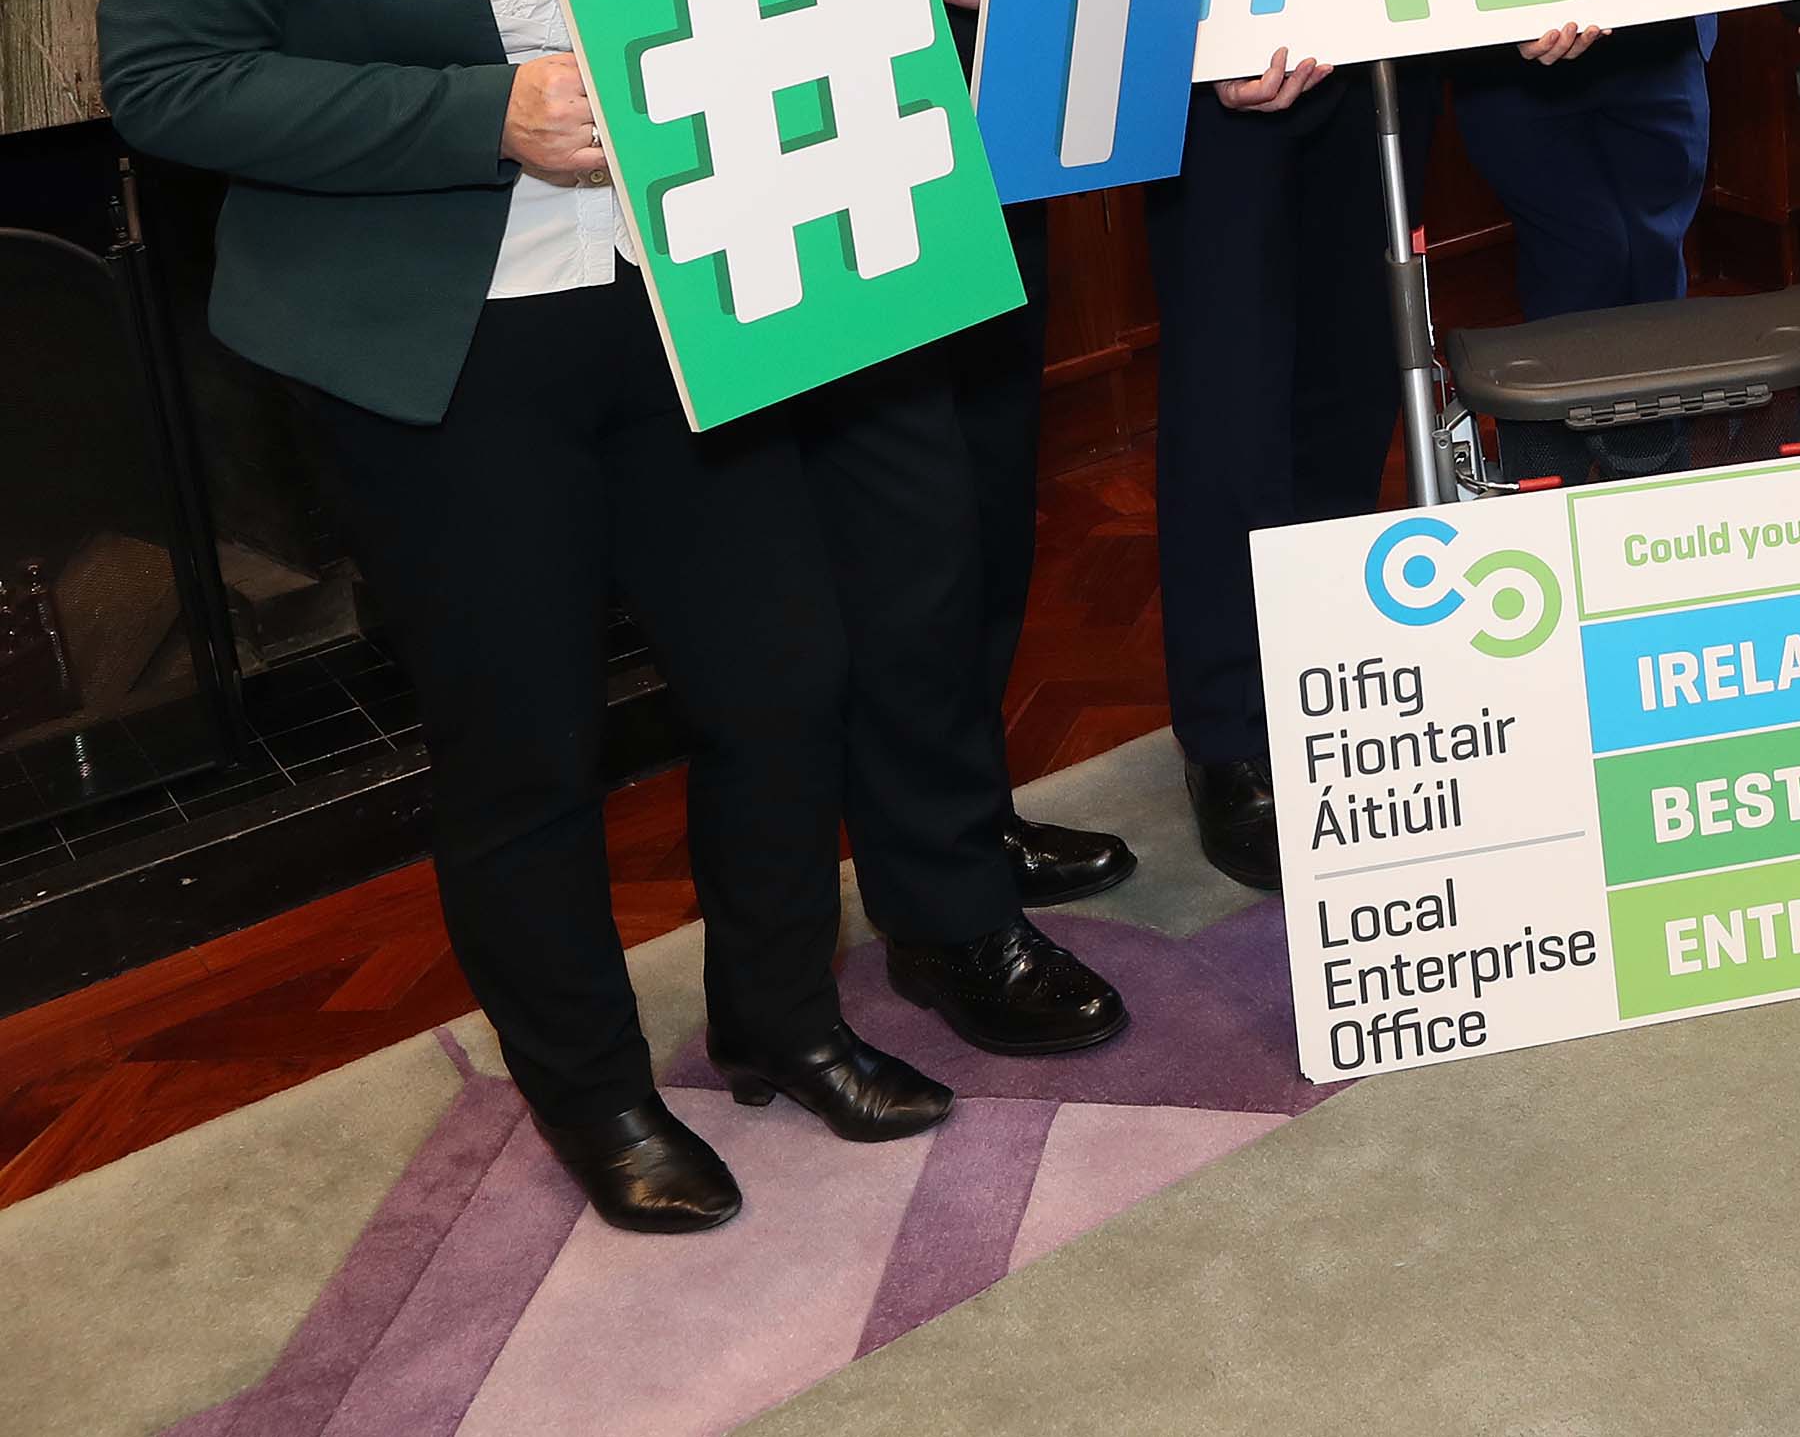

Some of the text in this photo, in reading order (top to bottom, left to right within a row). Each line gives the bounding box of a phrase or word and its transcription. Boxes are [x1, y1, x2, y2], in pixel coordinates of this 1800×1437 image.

[1624, 521, 1731, 566] Could
[1299, 657, 1423, 717] Oifig
[1305, 707, 1515, 783] Fiontair
[1311, 778, 1461, 850] Áitiúil
[1318, 878, 1457, 948] Local
[1325, 926, 1596, 1009] Enterprise
[1329, 1008, 1487, 1070] Office
